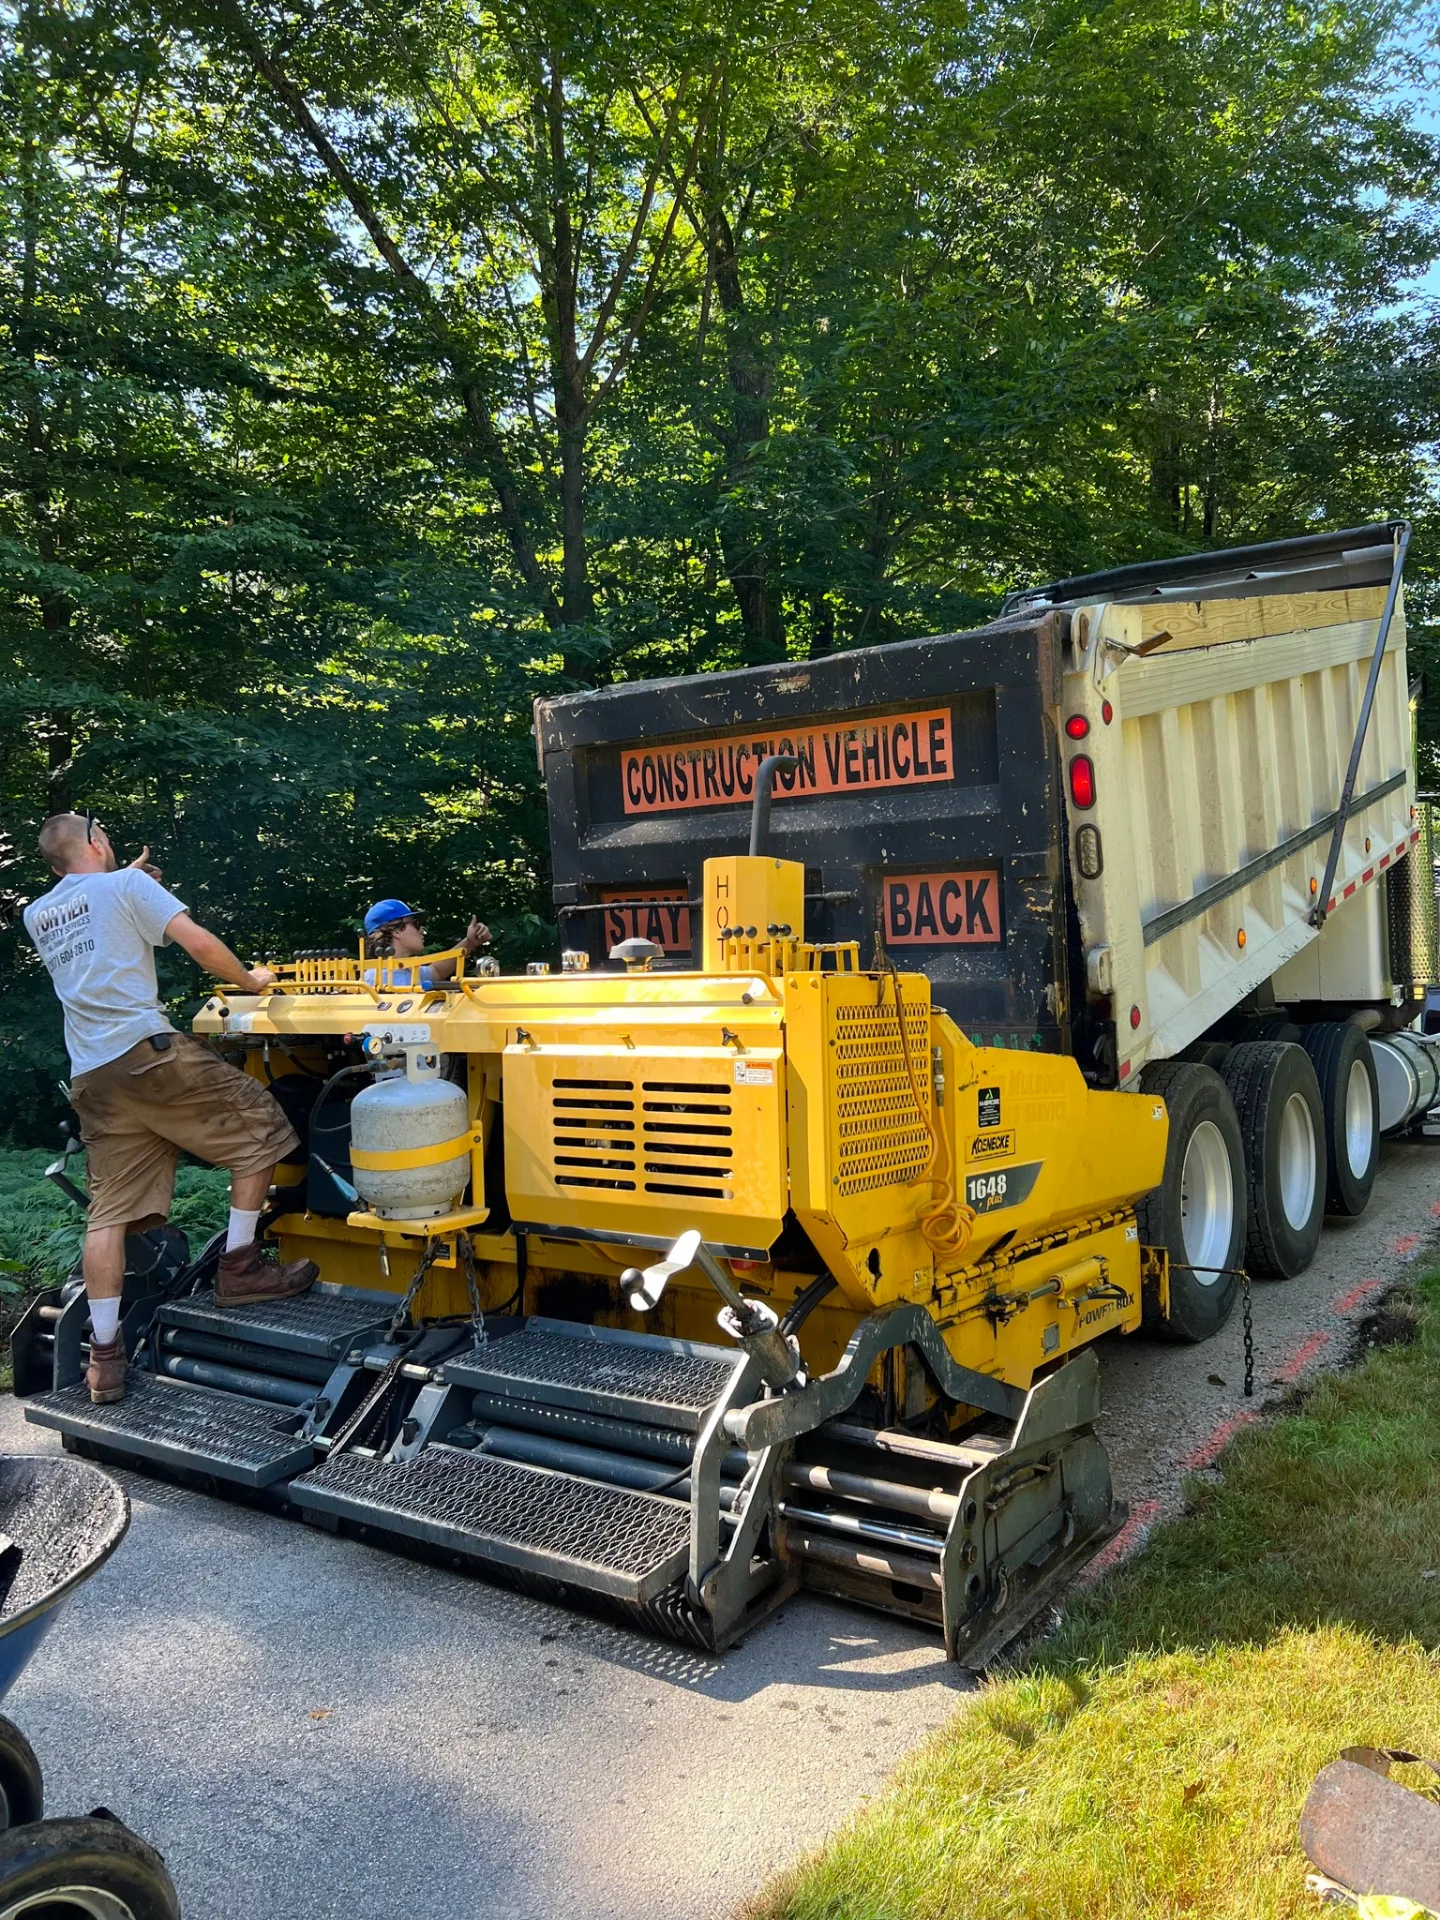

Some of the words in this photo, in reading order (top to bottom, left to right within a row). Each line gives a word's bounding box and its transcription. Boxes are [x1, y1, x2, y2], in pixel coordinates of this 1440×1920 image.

[626, 734, 817, 806] CONSTRUCTION
[822, 717, 948, 786] VEHICLE
[33, 894, 89, 936] FORTIER
[65, 915, 91, 935] SERVICES
[609, 896, 684, 945] STAY
[889, 878, 994, 937] BACK
[968, 1174, 1007, 1201] 1648
